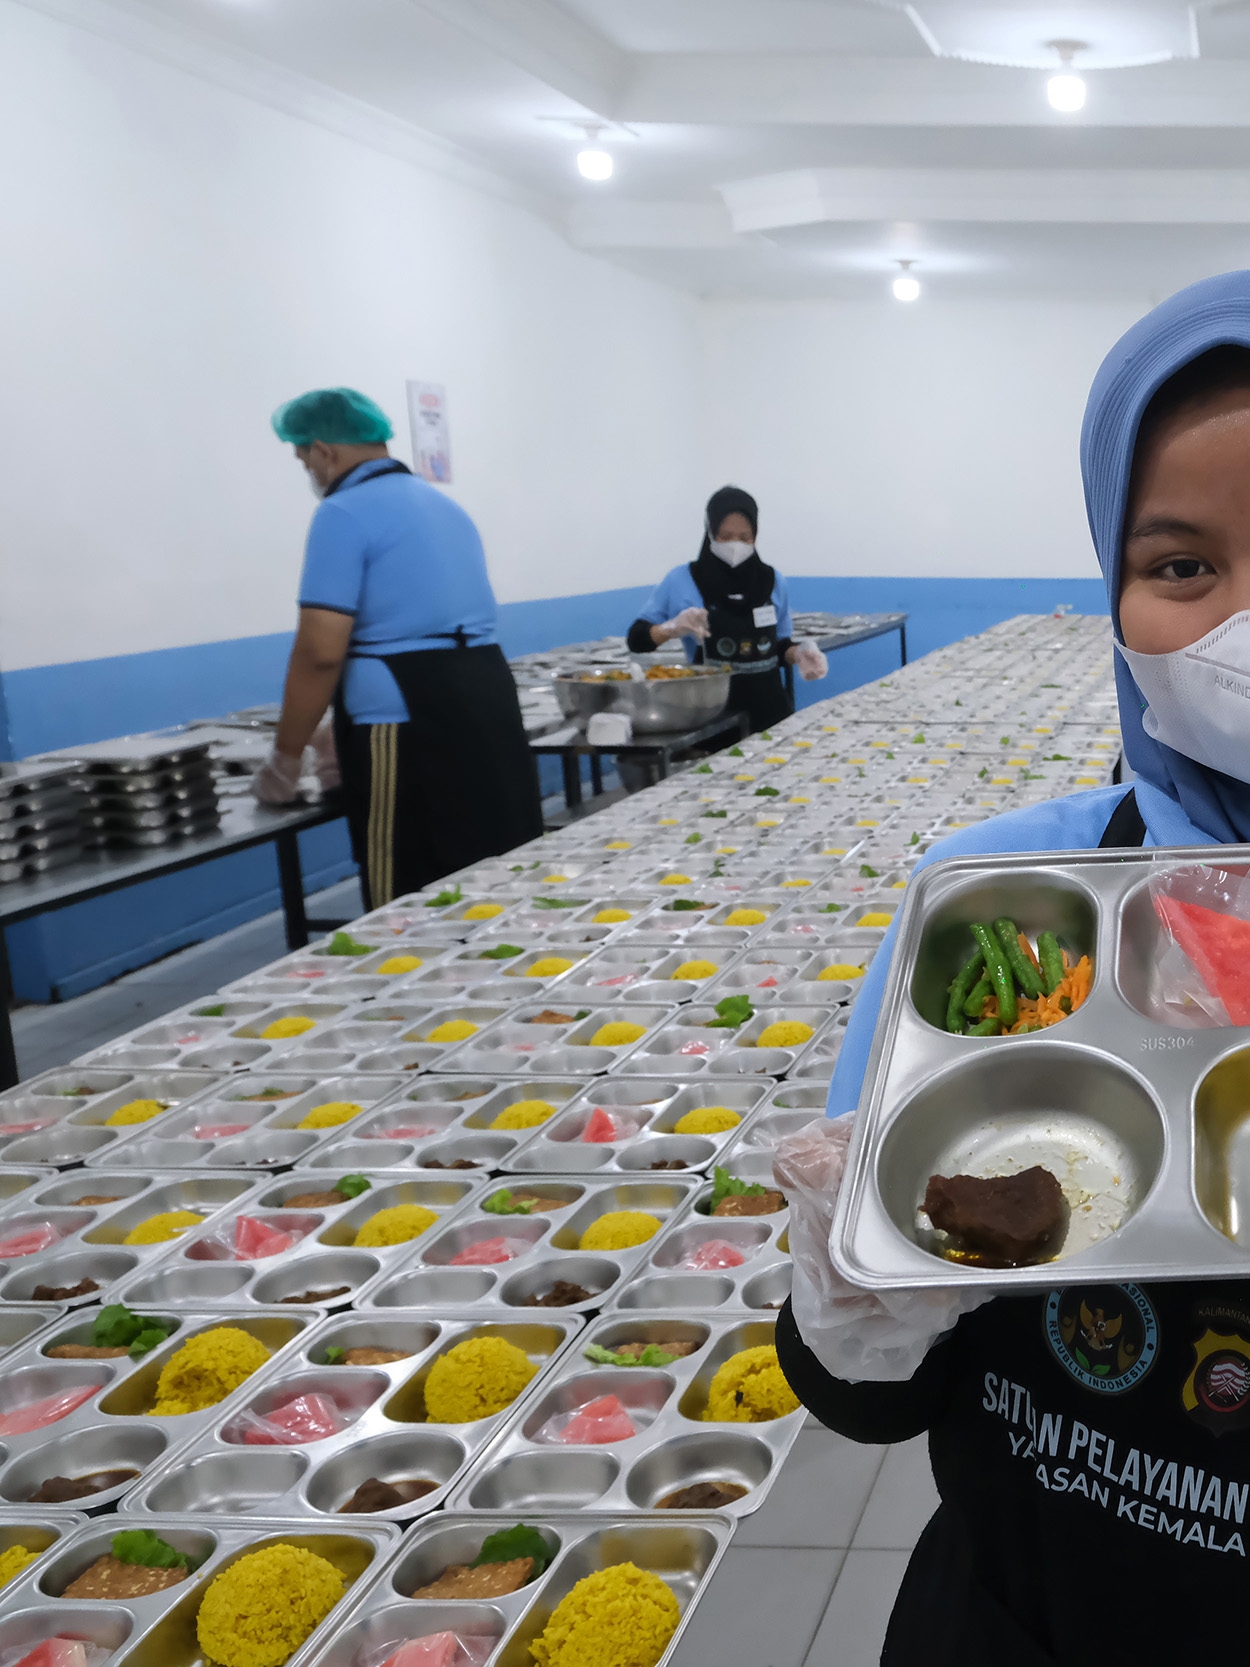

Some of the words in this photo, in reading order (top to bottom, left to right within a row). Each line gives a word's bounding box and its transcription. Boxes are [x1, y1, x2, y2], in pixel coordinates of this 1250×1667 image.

[1140, 1036, 1195, 1052] SUS304
[1121, 1283, 1155, 1333] ASIONAL
[1049, 1320, 1085, 1380] REPUBLIK
[1088, 1359, 1148, 1390] INDONESIA
[982, 1371, 1063, 1457] SATUN
[1068, 1420, 1250, 1524] PELAYANAN
[1008, 1431, 1110, 1509] YAASAN
[1116, 1494, 1246, 1557] KEMALA
